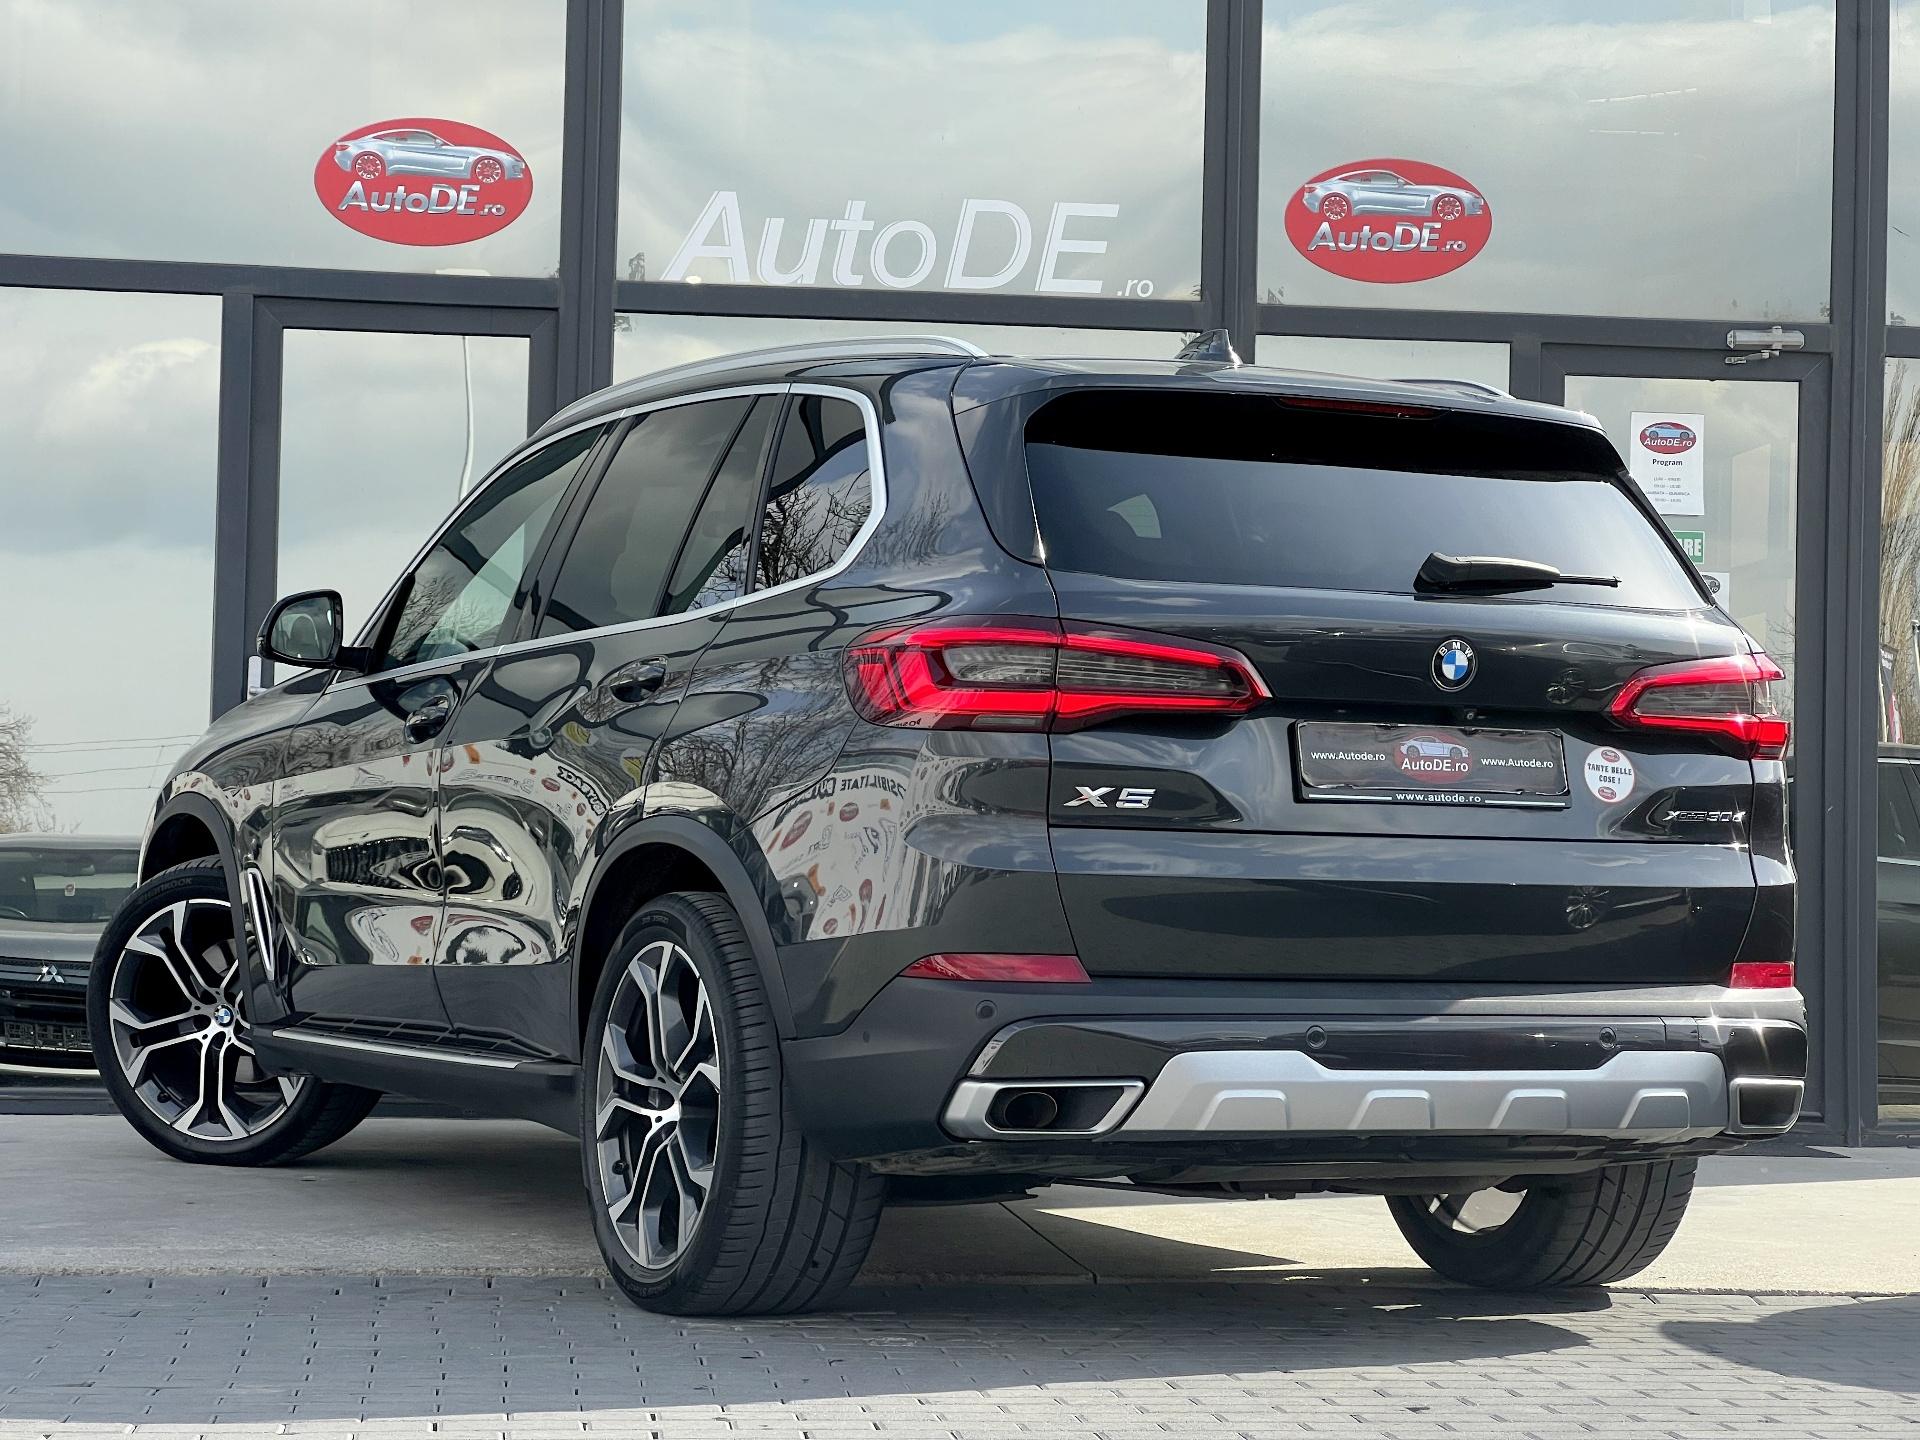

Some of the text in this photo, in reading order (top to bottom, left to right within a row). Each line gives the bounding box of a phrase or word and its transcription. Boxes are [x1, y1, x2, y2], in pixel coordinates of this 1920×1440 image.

[1643, 438, 1693, 448] AutoDE.ro
[1652, 458, 1683, 467] Program
[1438, 641, 1474, 658] BMW
[1310, 750, 1386, 762] www.Autode.ro
[1480, 756, 1554, 769] www.Autode.ro
[1401, 757, 1469, 773] AutoDE.ro
[1587, 762, 1633, 776] TANTE BELLE
[1063, 786, 1157, 809] X5
[1395, 792, 1482, 803] www.autode.ro
